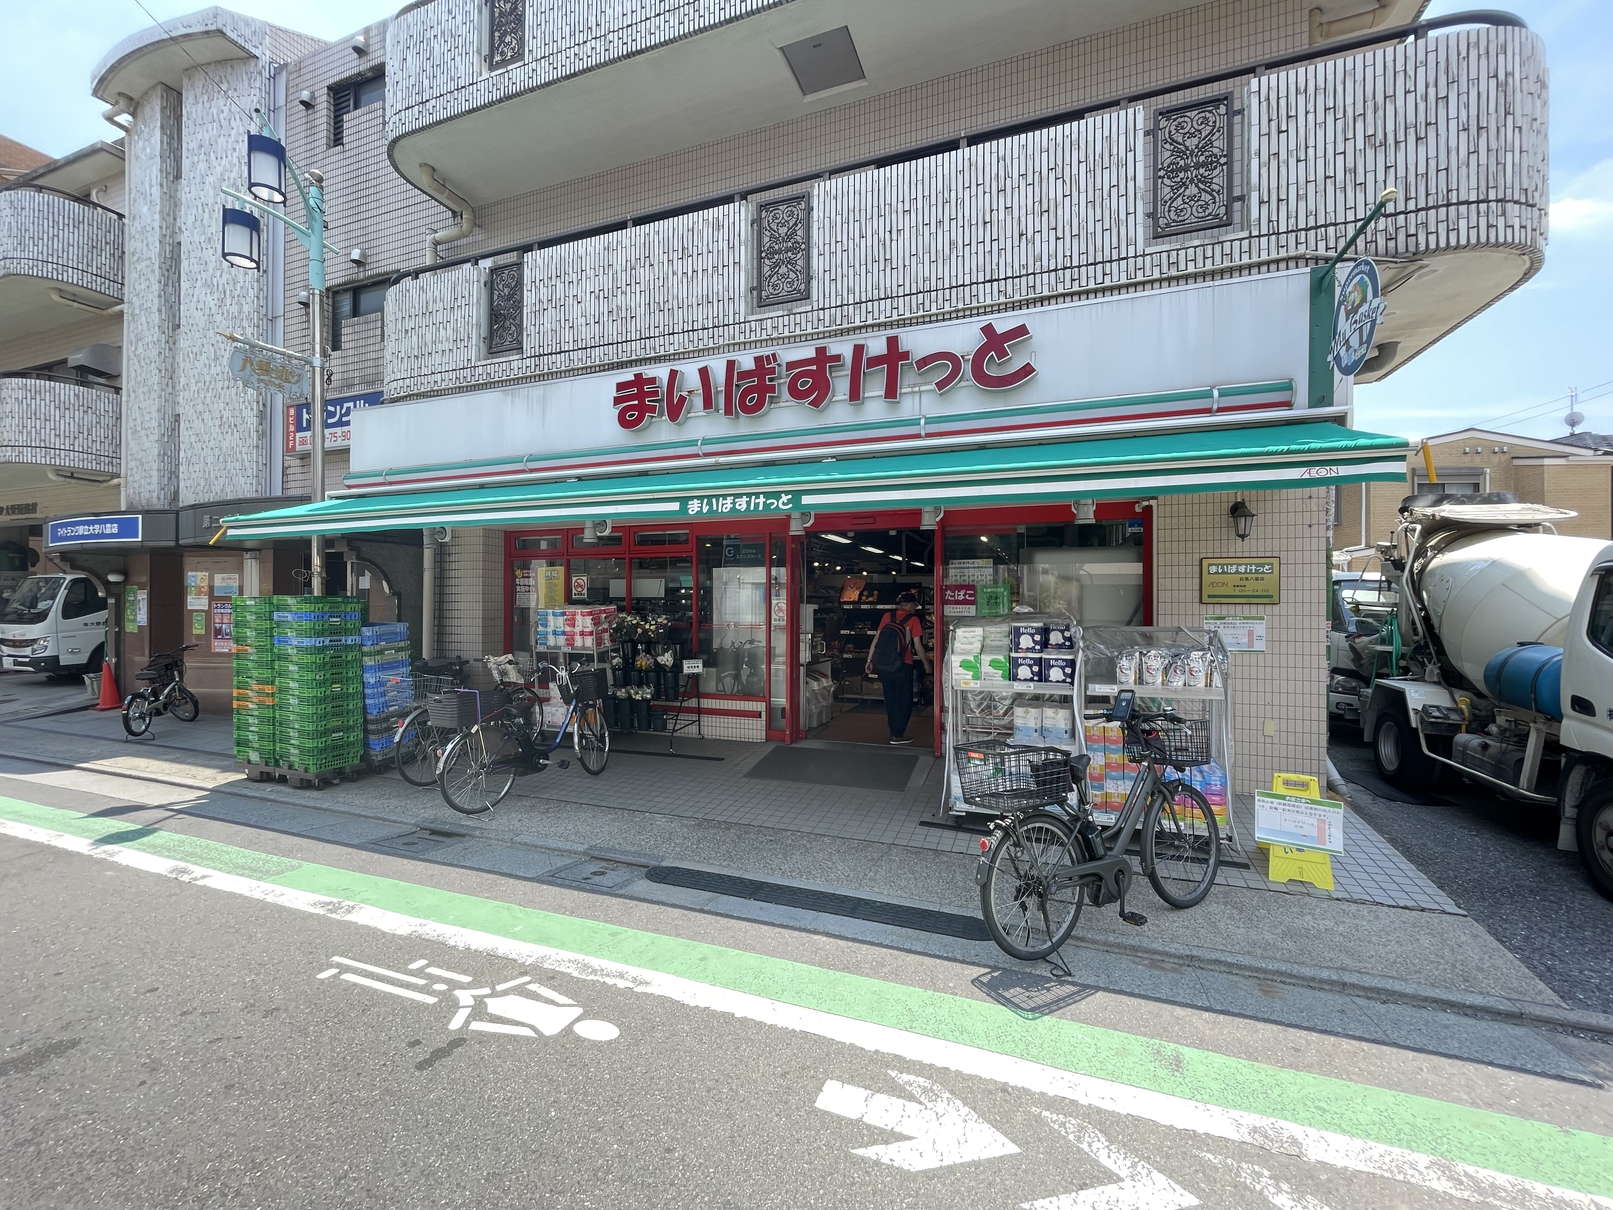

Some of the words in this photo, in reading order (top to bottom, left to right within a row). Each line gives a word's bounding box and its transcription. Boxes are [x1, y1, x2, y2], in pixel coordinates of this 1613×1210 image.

[613, 321, 1038, 432] まいばすけっと
[687, 493, 793, 515] まいばすけっと
[1208, 564, 1273, 573] まいばすけっと
[945, 589, 975, 601] たばこ
